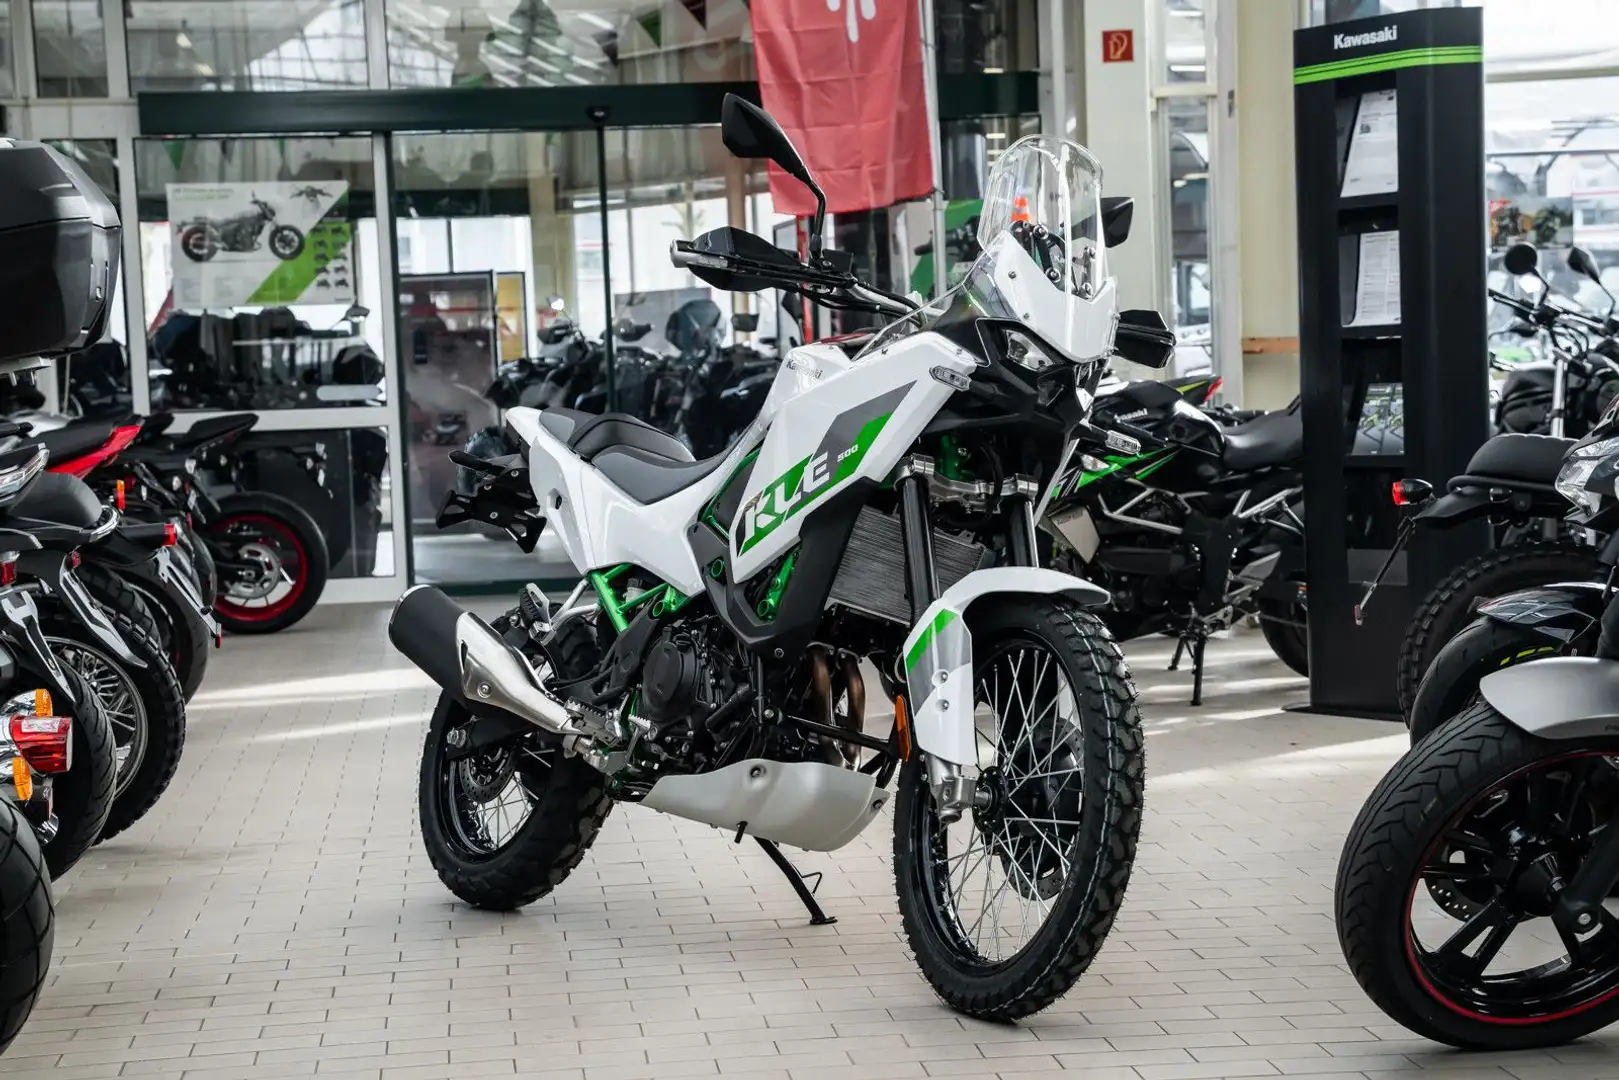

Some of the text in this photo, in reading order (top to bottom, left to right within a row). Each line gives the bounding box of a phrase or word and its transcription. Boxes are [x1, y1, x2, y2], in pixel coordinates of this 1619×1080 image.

[1333, 25, 1398, 50] Kawasaki
[745, 444, 859, 542] KLE 500
